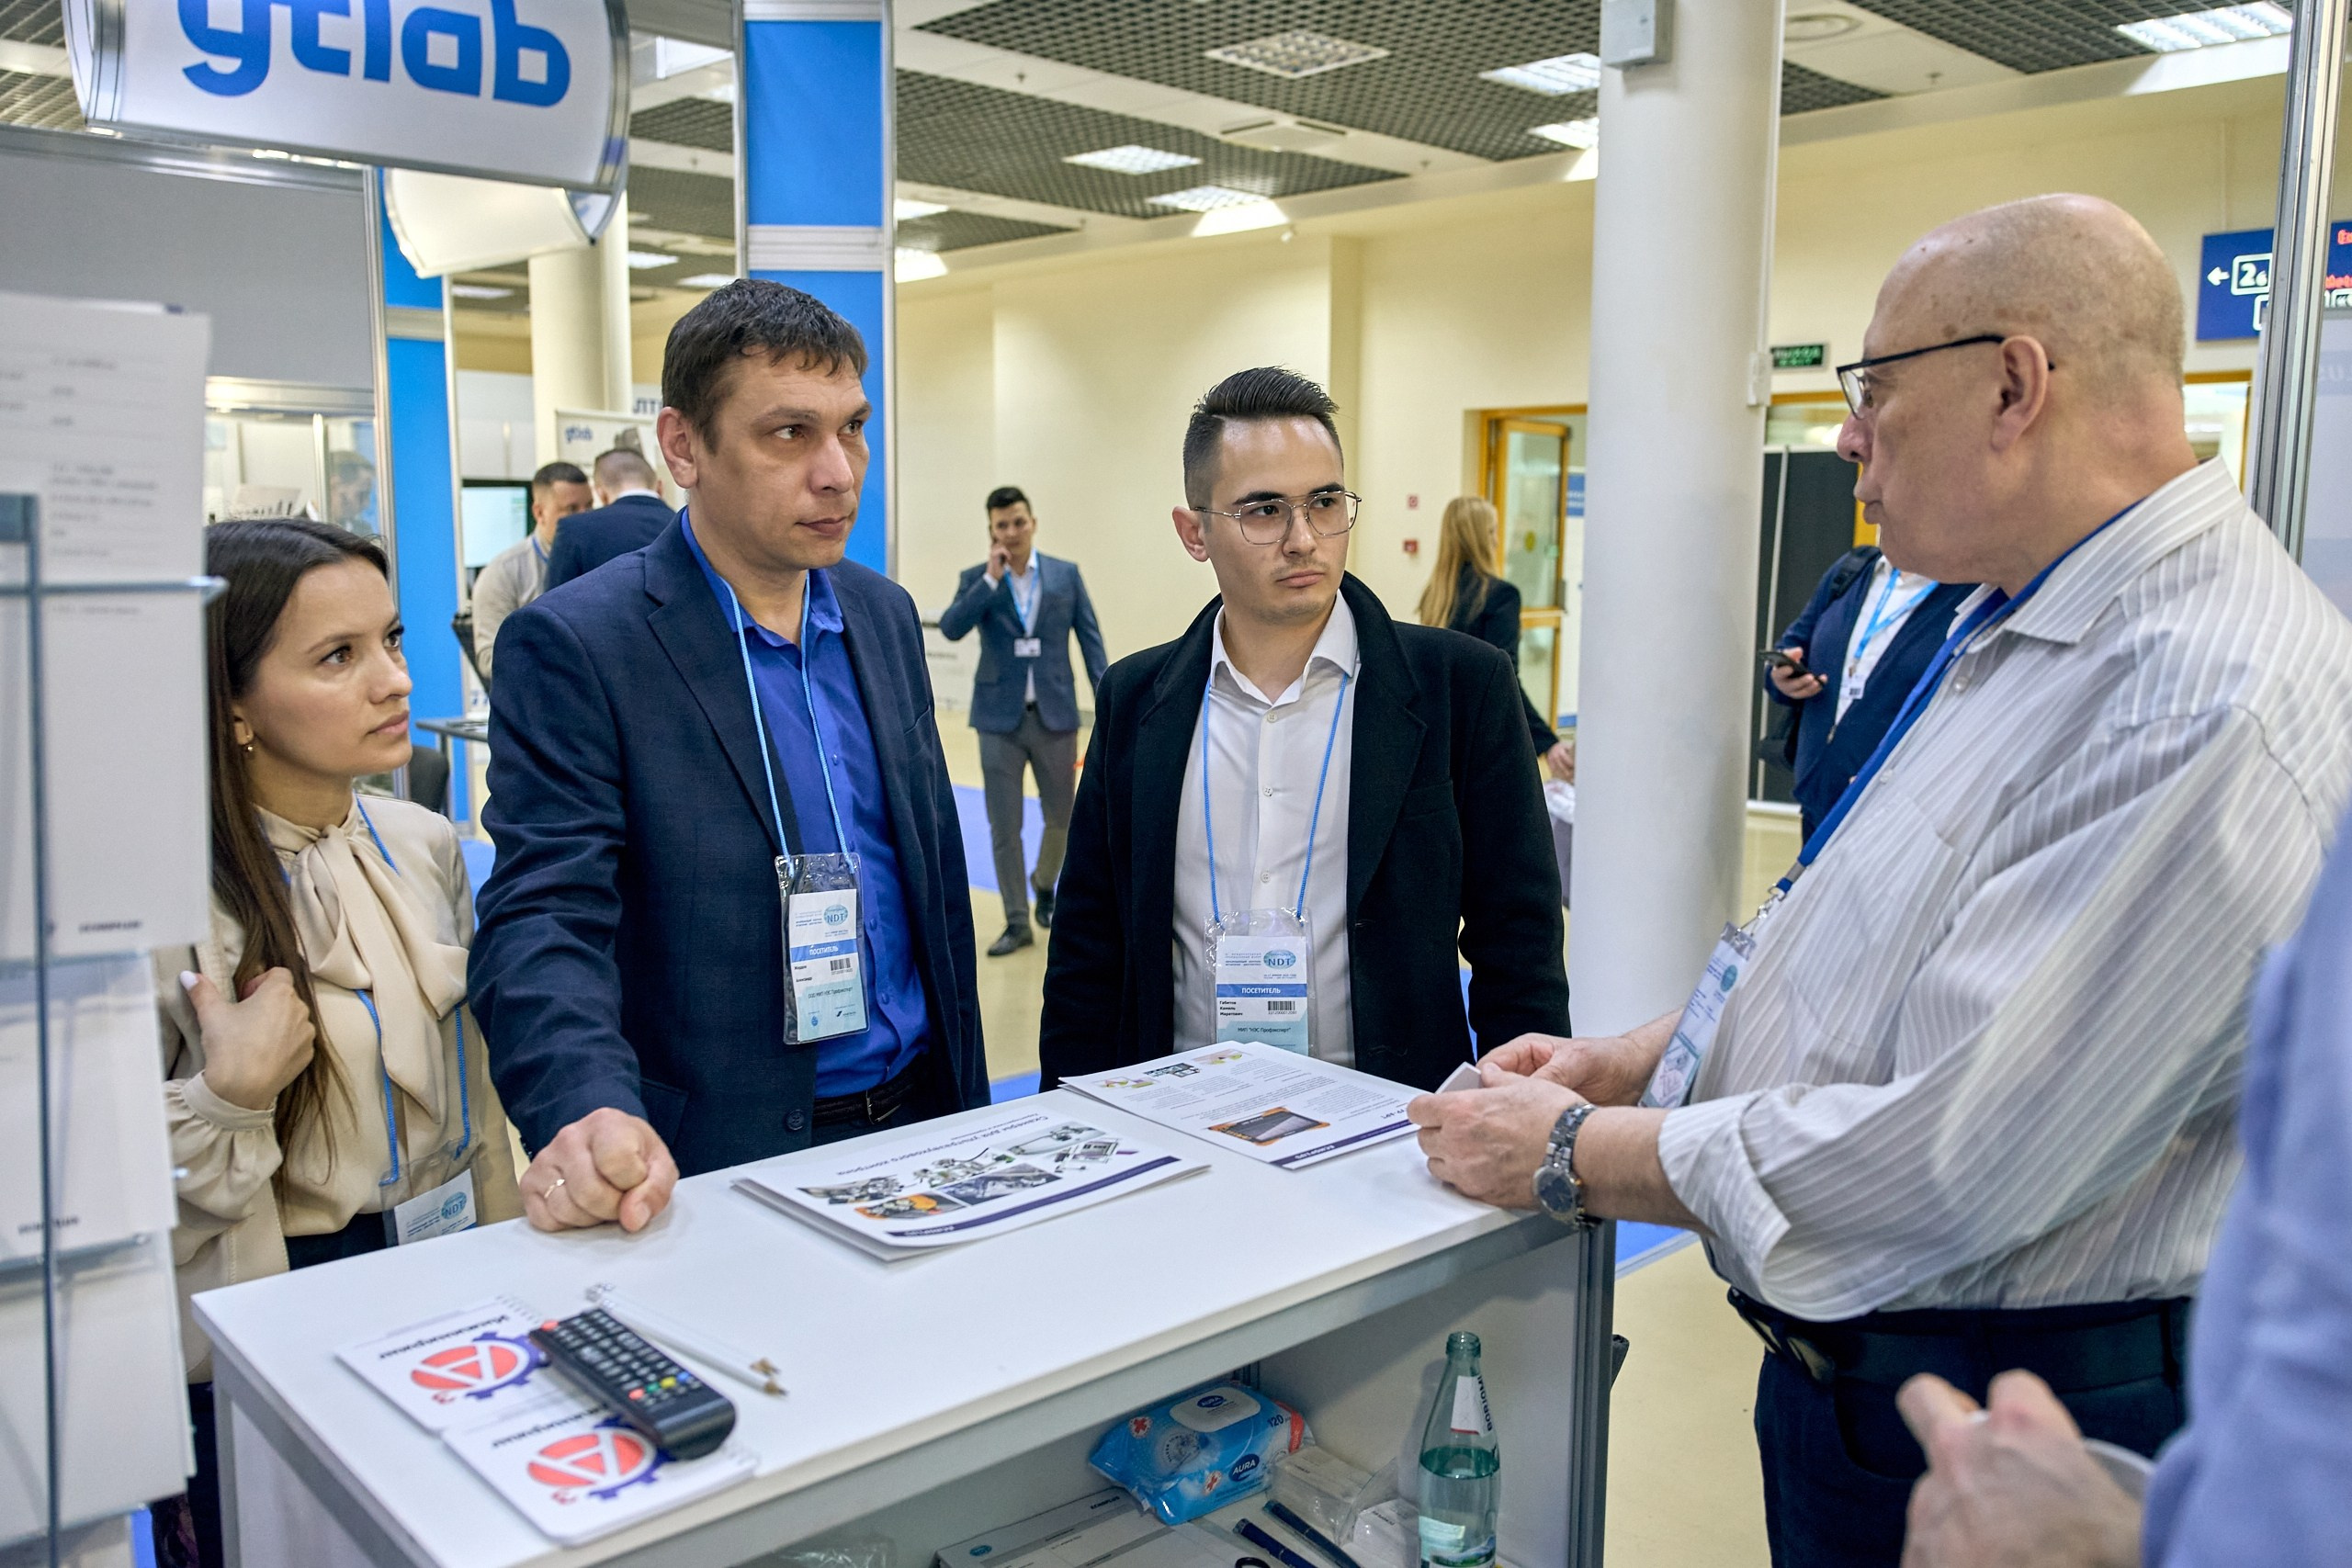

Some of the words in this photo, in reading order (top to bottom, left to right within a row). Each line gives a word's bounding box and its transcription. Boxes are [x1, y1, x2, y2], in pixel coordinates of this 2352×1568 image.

[177, 0, 571, 107] gtlab
[827, 913, 844, 923] NDT
[808, 946, 839, 956] ПОСЕТИТЕЛЬ
[1268, 958, 1291, 966] NDT
[445, 1201, 464, 1216] NDT
[1267, 1414, 1284, 1427] 120
[1232, 1459, 1257, 1475] AURA
